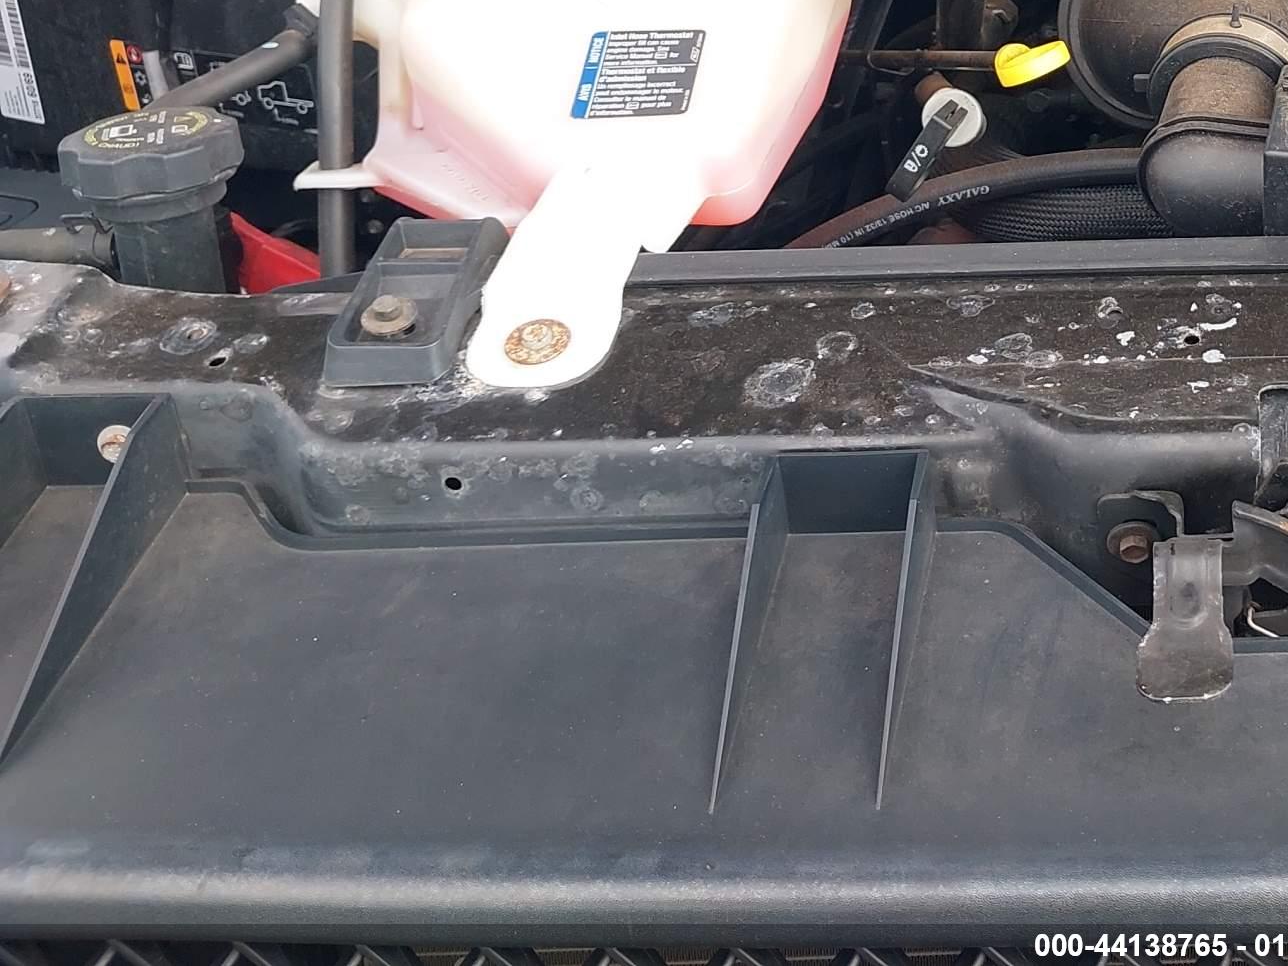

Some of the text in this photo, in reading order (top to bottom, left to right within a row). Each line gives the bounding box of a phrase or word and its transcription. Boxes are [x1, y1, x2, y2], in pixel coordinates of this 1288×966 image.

[590, 37, 604, 63] NOTICE
[937, 186, 990, 206] GALAXY
[889, 210, 914, 223] HOSE
